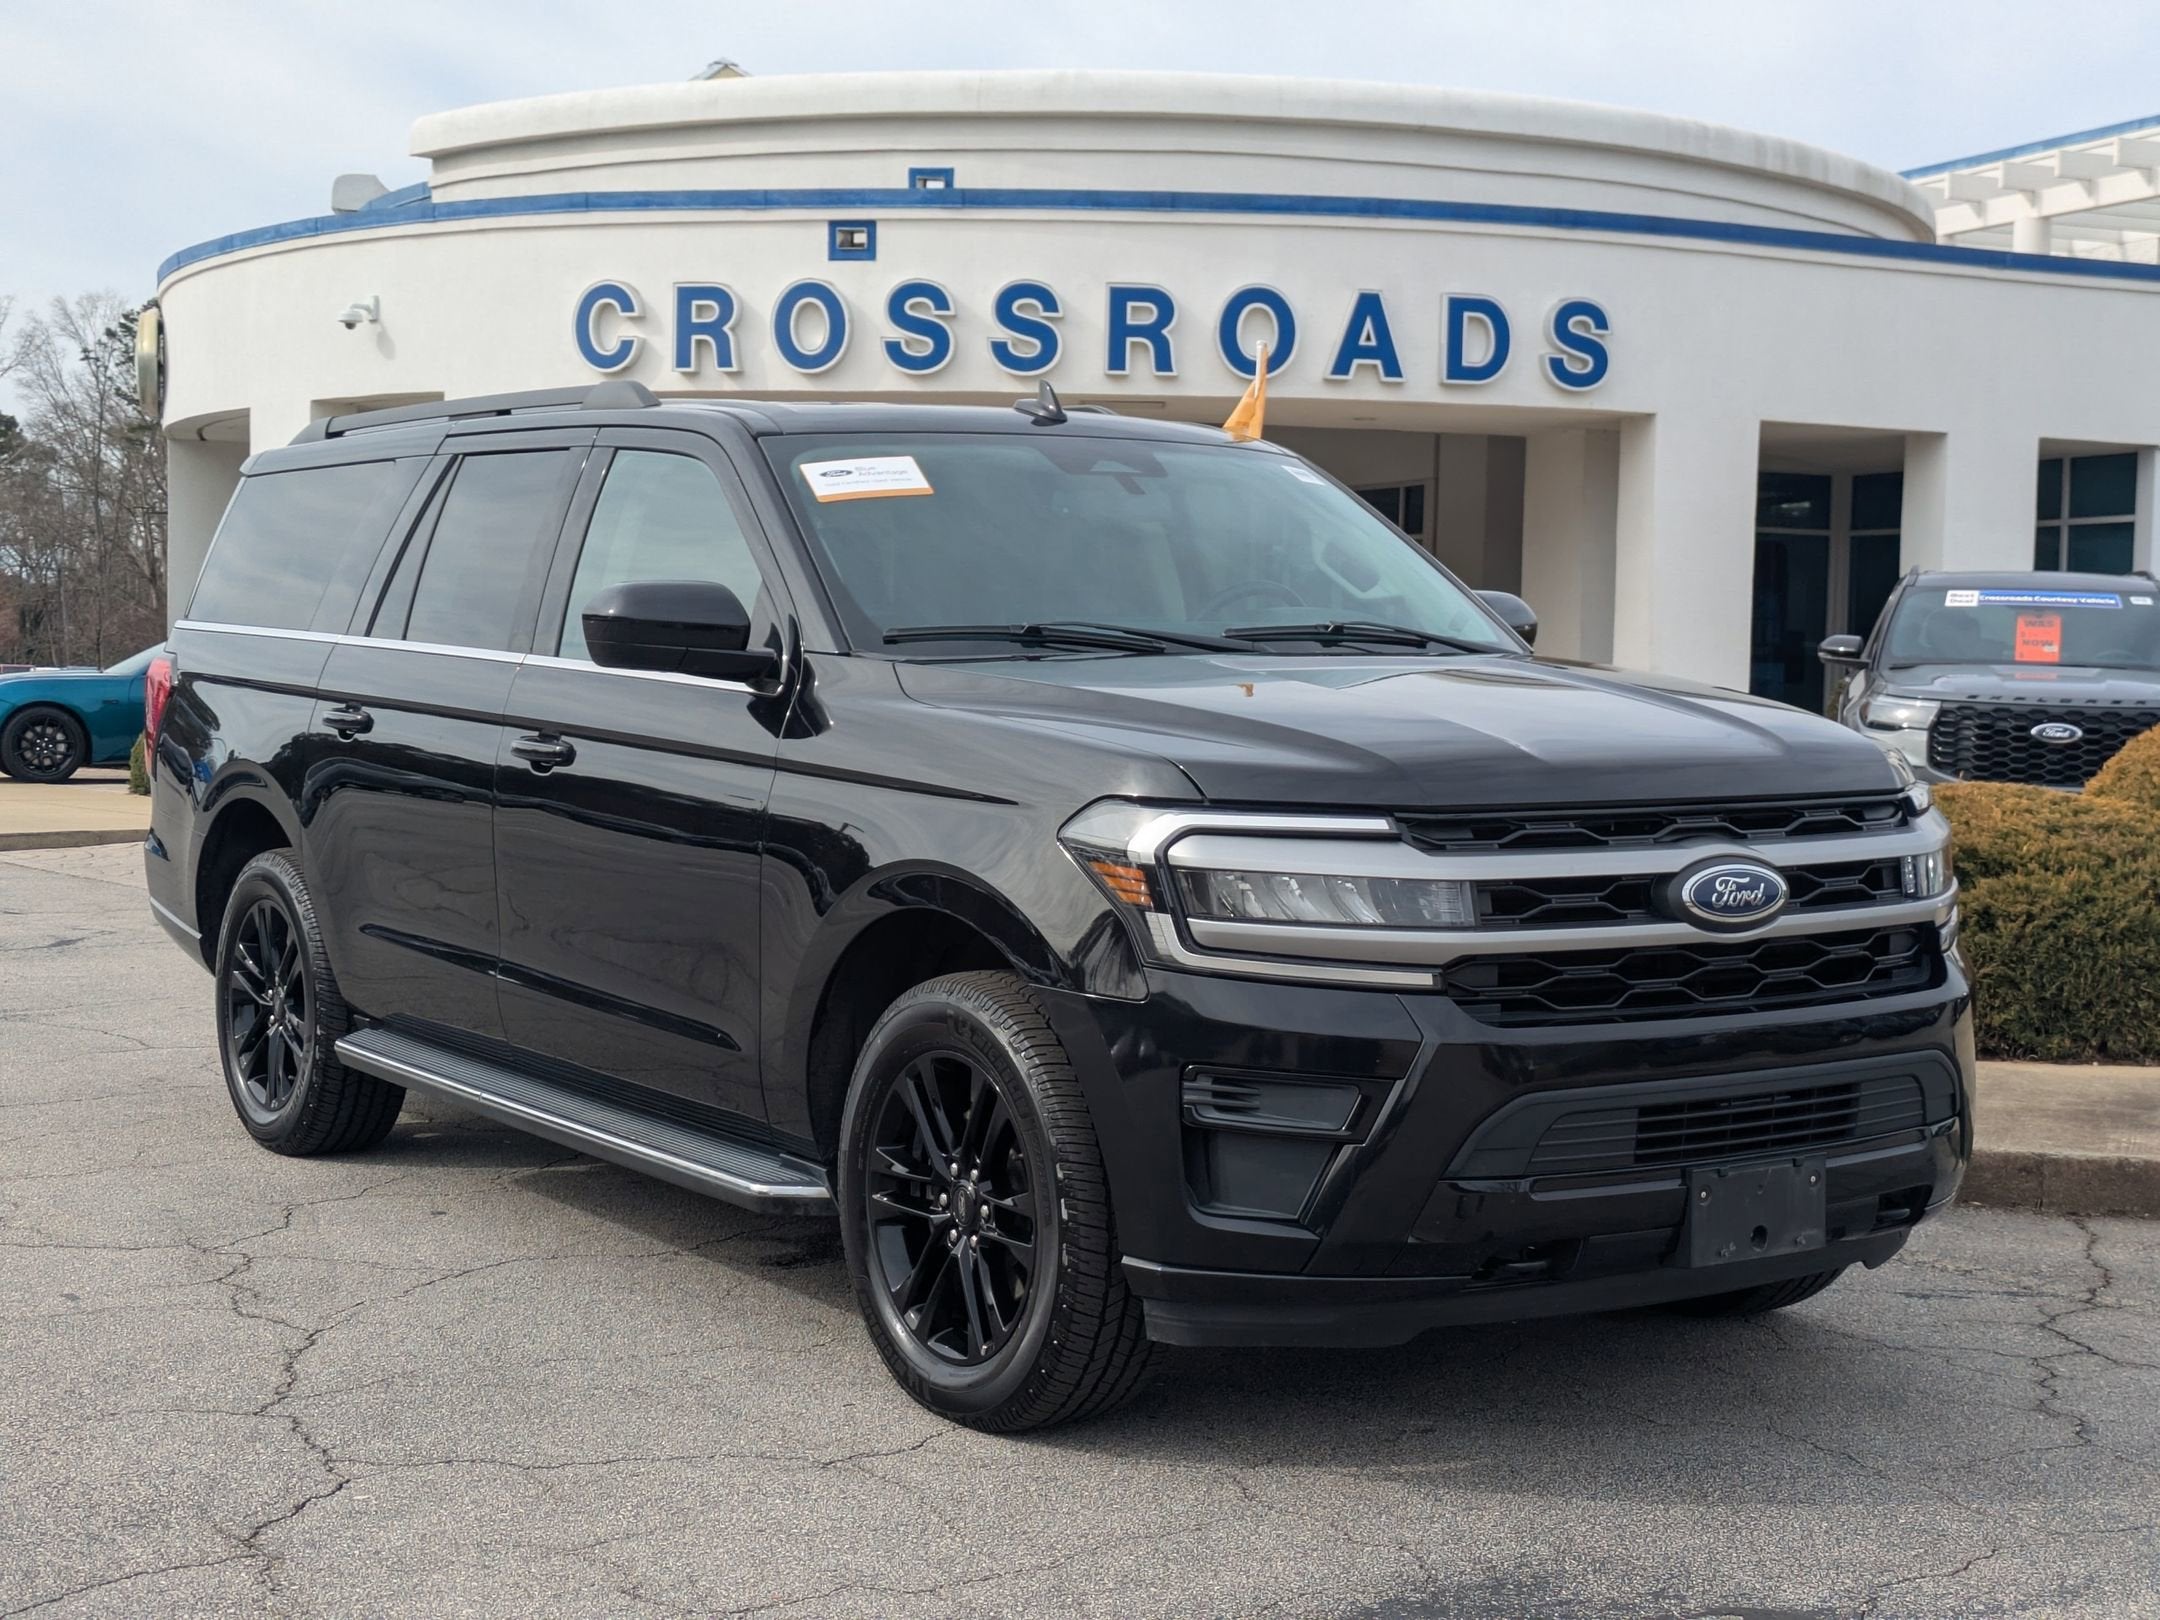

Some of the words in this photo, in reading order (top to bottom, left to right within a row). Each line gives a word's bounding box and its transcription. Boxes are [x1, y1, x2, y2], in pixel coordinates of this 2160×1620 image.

[574, 279, 1613, 391] CROSSROADS
[2042, 726, 2071, 738] Ford
[1711, 876, 1766, 908] Ford
